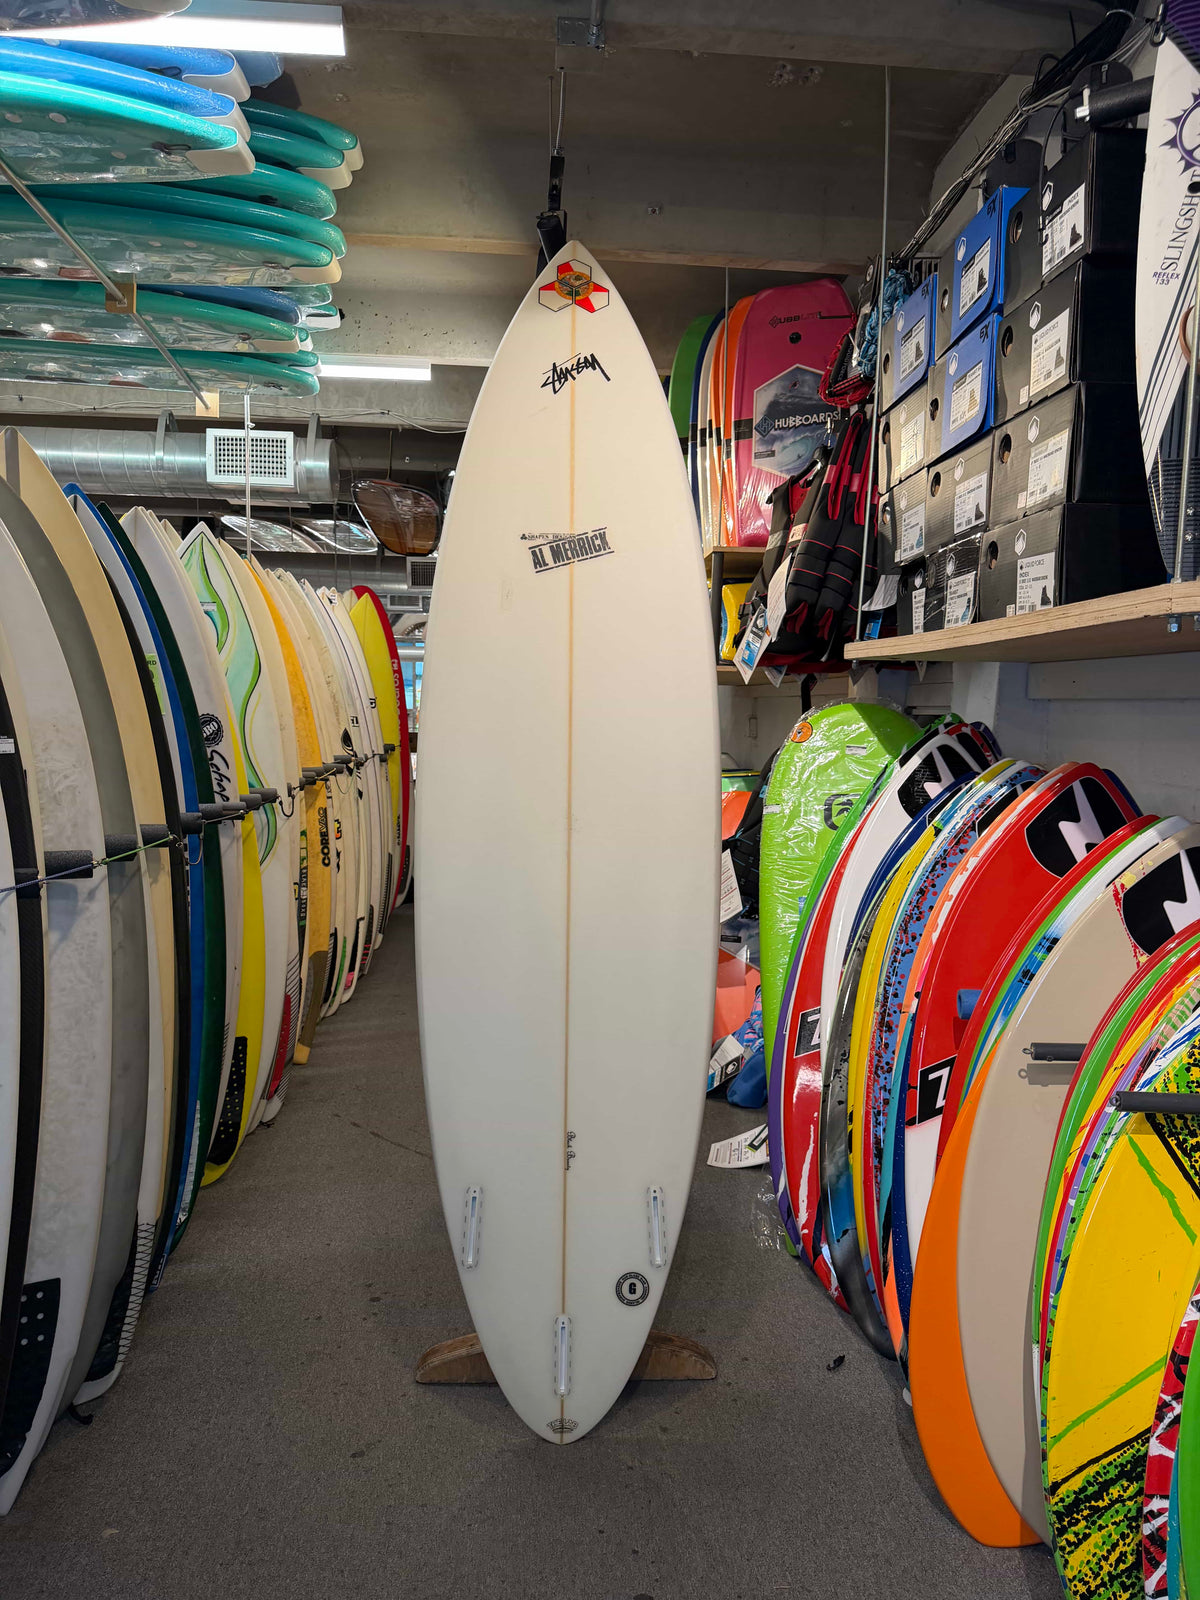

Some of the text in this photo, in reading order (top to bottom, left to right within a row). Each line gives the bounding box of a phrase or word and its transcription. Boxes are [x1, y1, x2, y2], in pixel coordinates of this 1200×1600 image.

[1152, 271, 1181, 280] REFLEX
[530, 530, 612, 570] AL MERRICK
[628, 1281, 637, 1295] G
